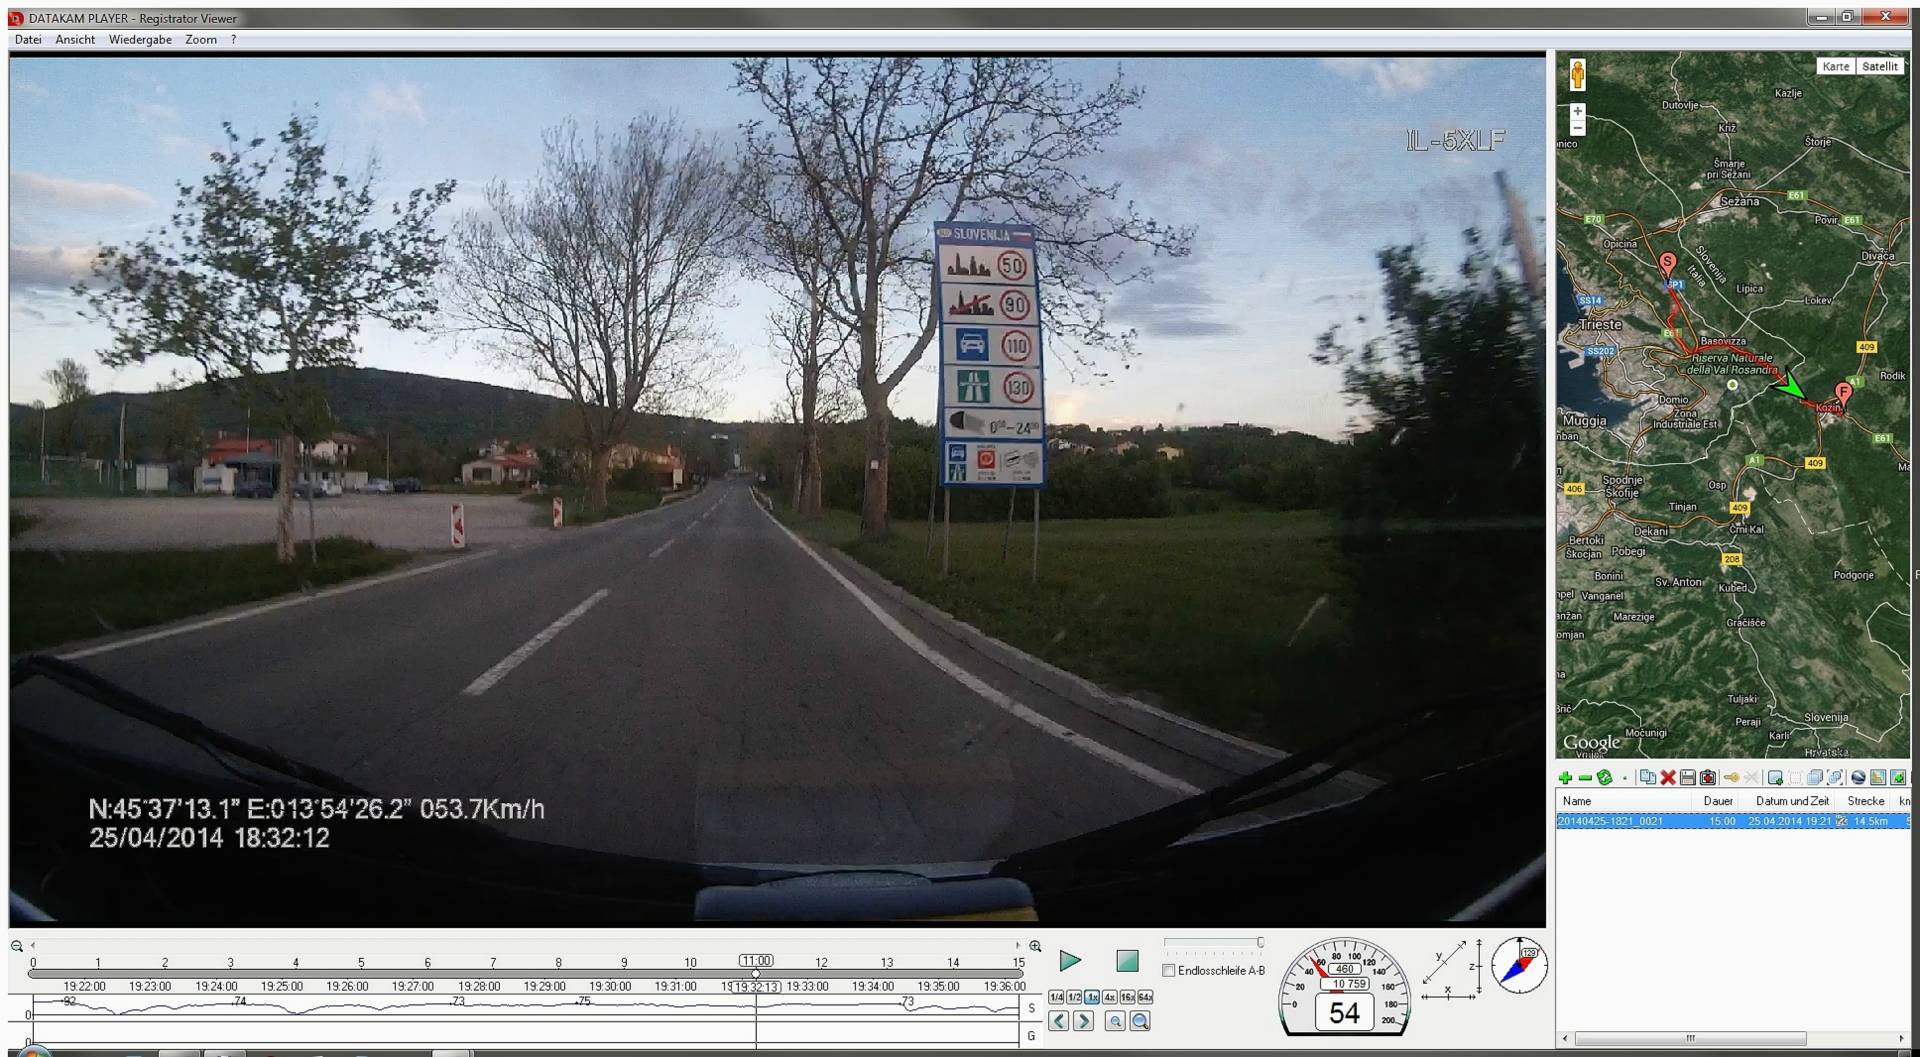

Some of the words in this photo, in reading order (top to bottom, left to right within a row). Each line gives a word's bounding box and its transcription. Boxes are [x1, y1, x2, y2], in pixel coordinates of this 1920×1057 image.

[29, 14, 84, 23] DATAKAM
[88, 14, 128, 23] PLAYER
[140, 14, 198, 26] Registrator
[200, 14, 237, 23] Viewer
[15, 35, 41, 44] Datei
[56, 35, 95, 44] Ansicht
[109, 35, 172, 47] Wiedergabe
[185, 35, 217, 44] Zoom
[231, 35, 235, 44] ?
[1823, 62, 1849, 71] Karte
[1863, 62, 1898, 71] Satellit
[1775, 89, 1802, 99] Kazlje
[1663, 101, 1699, 111] Dutovlje
[1719, 123, 1736, 133] Križ
[1805, 136, 1832, 148] Štorje
[1714, 160, 1745, 170] Šmarje
[1707, 170, 1719, 179] pri
[1721, 169, 1750, 179] Sežani
[1721, 196, 1760, 206] Sežana
[1815, 216, 1837, 224] Povir
[954, 228, 1010, 241] SLOVENIJA
[1603, 240, 1637, 249] Opicina
[1862, 251, 1895, 261] Divača
[1003, 258, 1022, 273] 50
[1663, 256, 1671, 266] S
[1695, 245, 1727, 284] Slovenija
[1687, 265, 1706, 288] Italia
[1736, 284, 1764, 294] Lipica
[1005, 297, 1024, 312] 90
[1805, 296, 1832, 305] Lokev
[1580, 319, 1622, 330] Trieste
[1701, 337, 1746, 345] Basovizza
[1008, 339, 1027, 354] 110
[1692, 354, 1728, 362] Riserva
[1730, 354, 1773, 362] Naturale
[1687, 365, 1709, 374] della
[1711, 366, 1729, 374] Val
[1731, 365, 1778, 374] Rosandra
[1880, 372, 1905, 380] Rodik
[1008, 380, 1029, 395] 130
[1840, 387, 1848, 395] F
[1659, 396, 1688, 404] Domio
[1674, 410, 1696, 418] Zona
[1563, 415, 1607, 428] Muggia
[1653, 420, 1700, 429] Industriale
[1703, 420, 1717, 429] Est
[1875, 434, 1890, 442] E61
[1603, 476, 1642, 485] Spodnje
[1709, 481, 1726, 490] Osp
[1606, 487, 1639, 498] Škofije
[1669, 502, 1696, 513] Tinjan
[1634, 527, 1668, 536] Dekani
[1750, 525, 1764, 534] Kal
[1569, 536, 1604, 545] Bertoki
[1566, 549, 1602, 560] Škocjan
[1612, 547, 1645, 557] Pobegi
[1594, 572, 1624, 581] Bonini
[1834, 571, 1874, 581] Podgorje
[1655, 578, 1670, 587] Sv.
[1673, 578, 1702, 587] Anton
[1719, 584, 1747, 593] Kubed
[1582, 592, 1624, 602] Vanganel
[1614, 613, 1655, 622] Marezige
[1727, 618, 1766, 627] Gračišče
[1728, 695, 1757, 705] Tuljaki
[1804, 713, 1849, 723] Slovenija
[1736, 718, 1761, 728] Peraji
[1625, 728, 1667, 739] Močunigi
[1769, 732, 1790, 740] Karli
[1564, 735, 1620, 753] Google
[1563, 796, 1591, 806] Name
[1704, 796, 1733, 806] Dauer
[1756, 796, 1789, 806] Datum
[1791, 796, 1809, 806] und
[1811, 796, 1830, 806] Zeit
[1848, 796, 1885, 806] Strecke
[1558, 816, 1663, 828] 20140425-1821_0021
[1710, 817, 1736, 826] 15:00
[1748, 817, 1802, 826] 25.04.2014
[1806, 817, 1832, 826] 19:21
[1855, 817, 1888, 826] 14.5km
[744, 956, 771, 965] 11:00
[1332, 952, 1341, 960] 80
[1348, 952, 1361, 960] 100
[31, 958, 36, 967] 0
[96, 958, 100, 967] 1
[162, 958, 168, 967] 2
[228, 958, 234, 967] 3
[359, 958, 364, 967] 5
[425, 958, 430, 967] 6
[555, 958, 562, 967] 8
[621, 958, 627, 967] 9
[685, 958, 696, 967] 10
[816, 958, 827, 967] 12
[882, 958, 893, 967] 13
[948, 958, 959, 967] 14
[1014, 958, 1025, 967] 15
[1179, 966, 1246, 975] Endlosschleife
[1249, 966, 1265, 975] A-B
[1337, 965, 1353, 974] 460
[64, 982, 105, 991] 19:22:00
[130, 982, 171, 991] 19:23:00
[196, 982, 238, 991] 19:24:00
[261, 982, 303, 991] 19:25:00
[327, 982, 368, 991] 19:26:00
[392, 982, 434, 991] 19:27:00
[459, 982, 500, 991] 19:28:00
[524, 982, 566, 991] 19:29:00
[590, 982, 631, 991] 19:30:00
[655, 982, 697, 991] 19:31:00
[736, 983, 778, 992] 19:32:13
[787, 982, 829, 991] 19:33:00
[853, 982, 894, 991] 19:34:00
[918, 982, 960, 991] 19:35:00
[985, 982, 1026, 991] 19:36:00
[1335, 980, 1344, 988] 10
[1349, 980, 1365, 989] 759
[1051, 993, 1063, 1001] 1/4
[1069, 993, 1081, 1001] 1/2
[1088, 993, 1097, 1001] 1x
[1105, 993, 1114, 1001] 4x
[1329, 1002, 1360, 1024] 54
